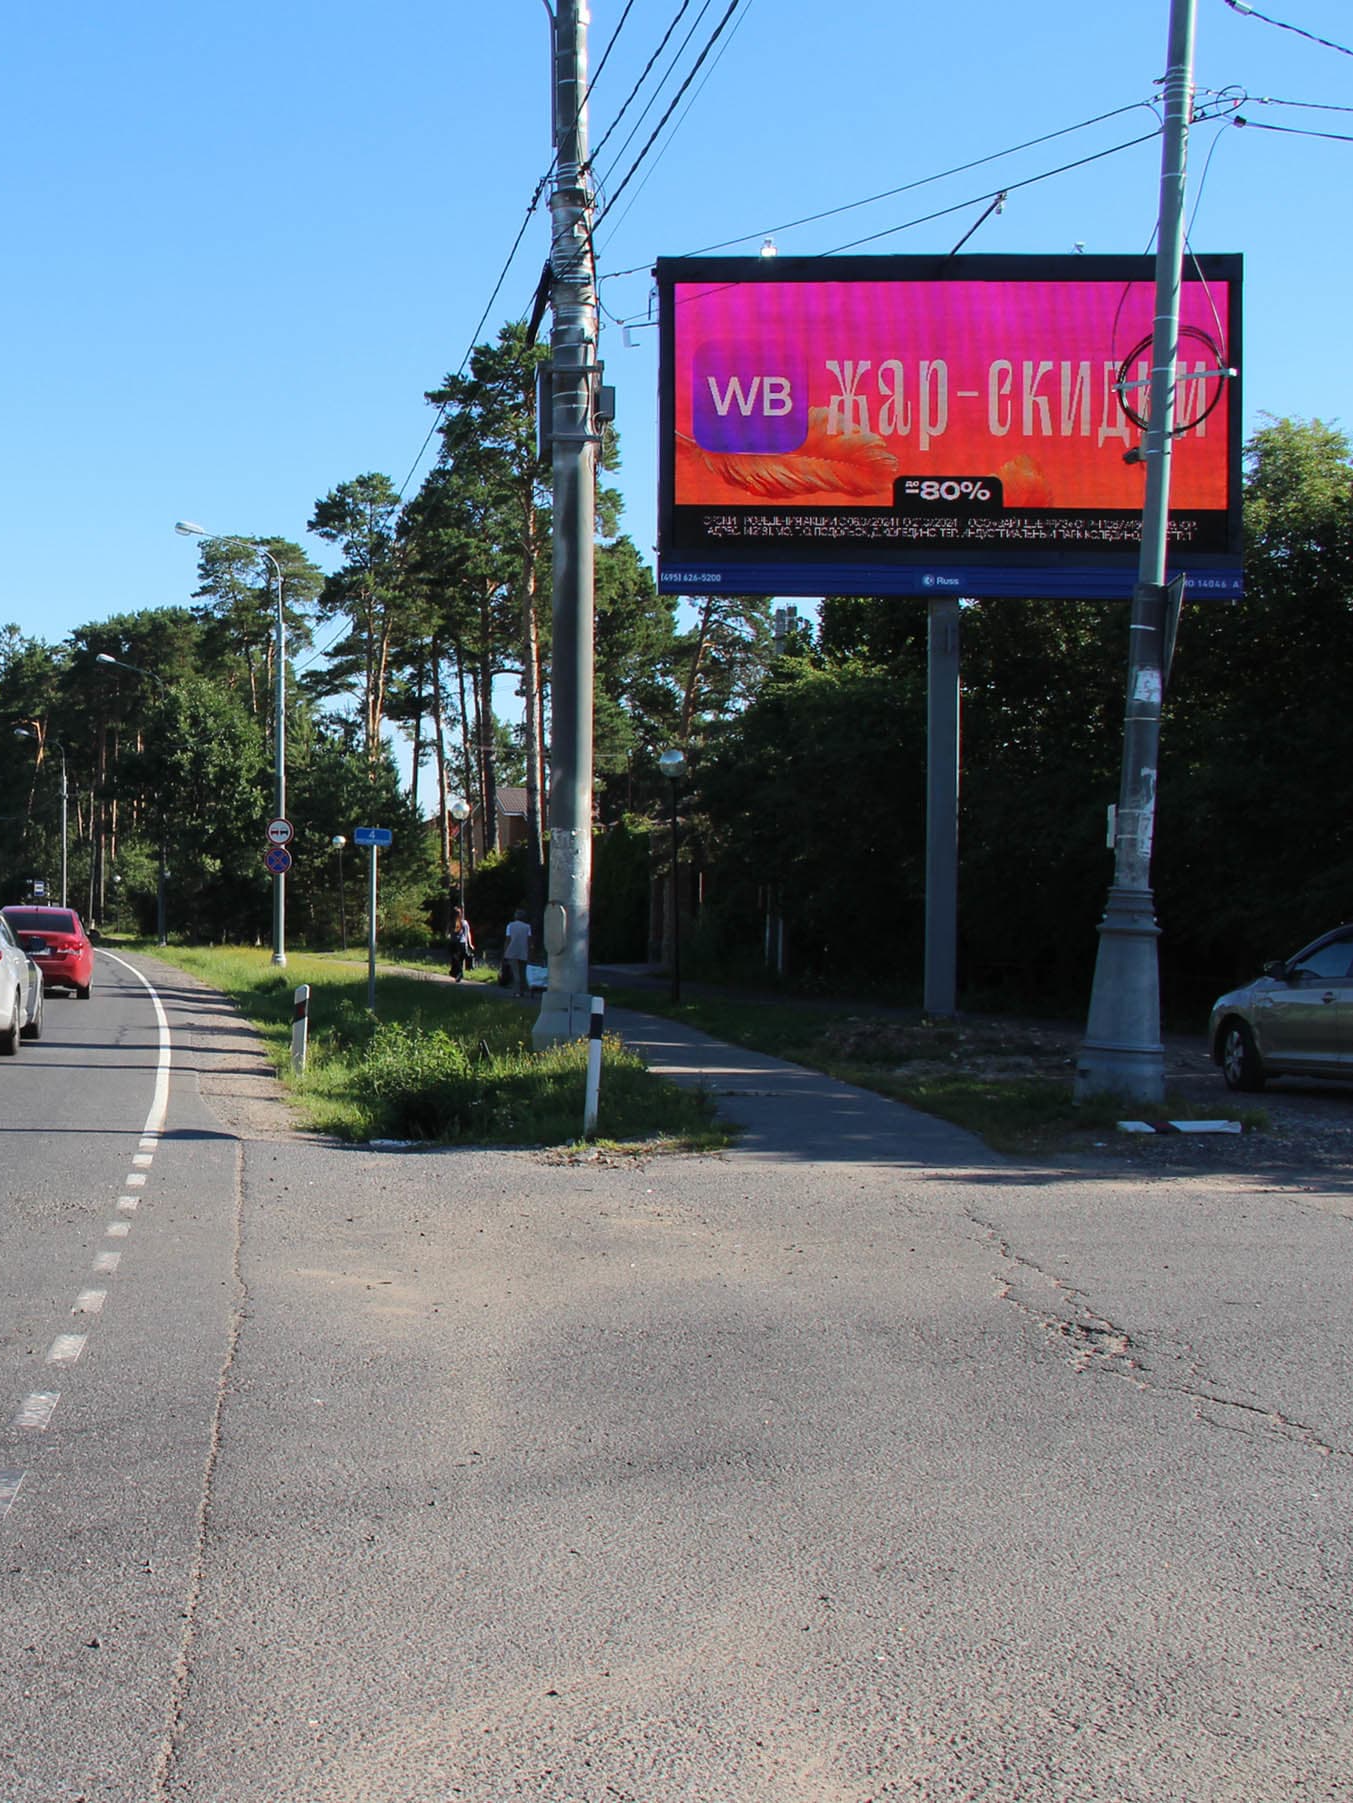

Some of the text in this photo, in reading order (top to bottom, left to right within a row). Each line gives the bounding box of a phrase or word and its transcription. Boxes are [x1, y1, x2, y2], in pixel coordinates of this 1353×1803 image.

[706, 376, 793, 417] WB
[661, 572, 722, 582] (495) 626-5200
[936, 576, 960, 585] Russ
